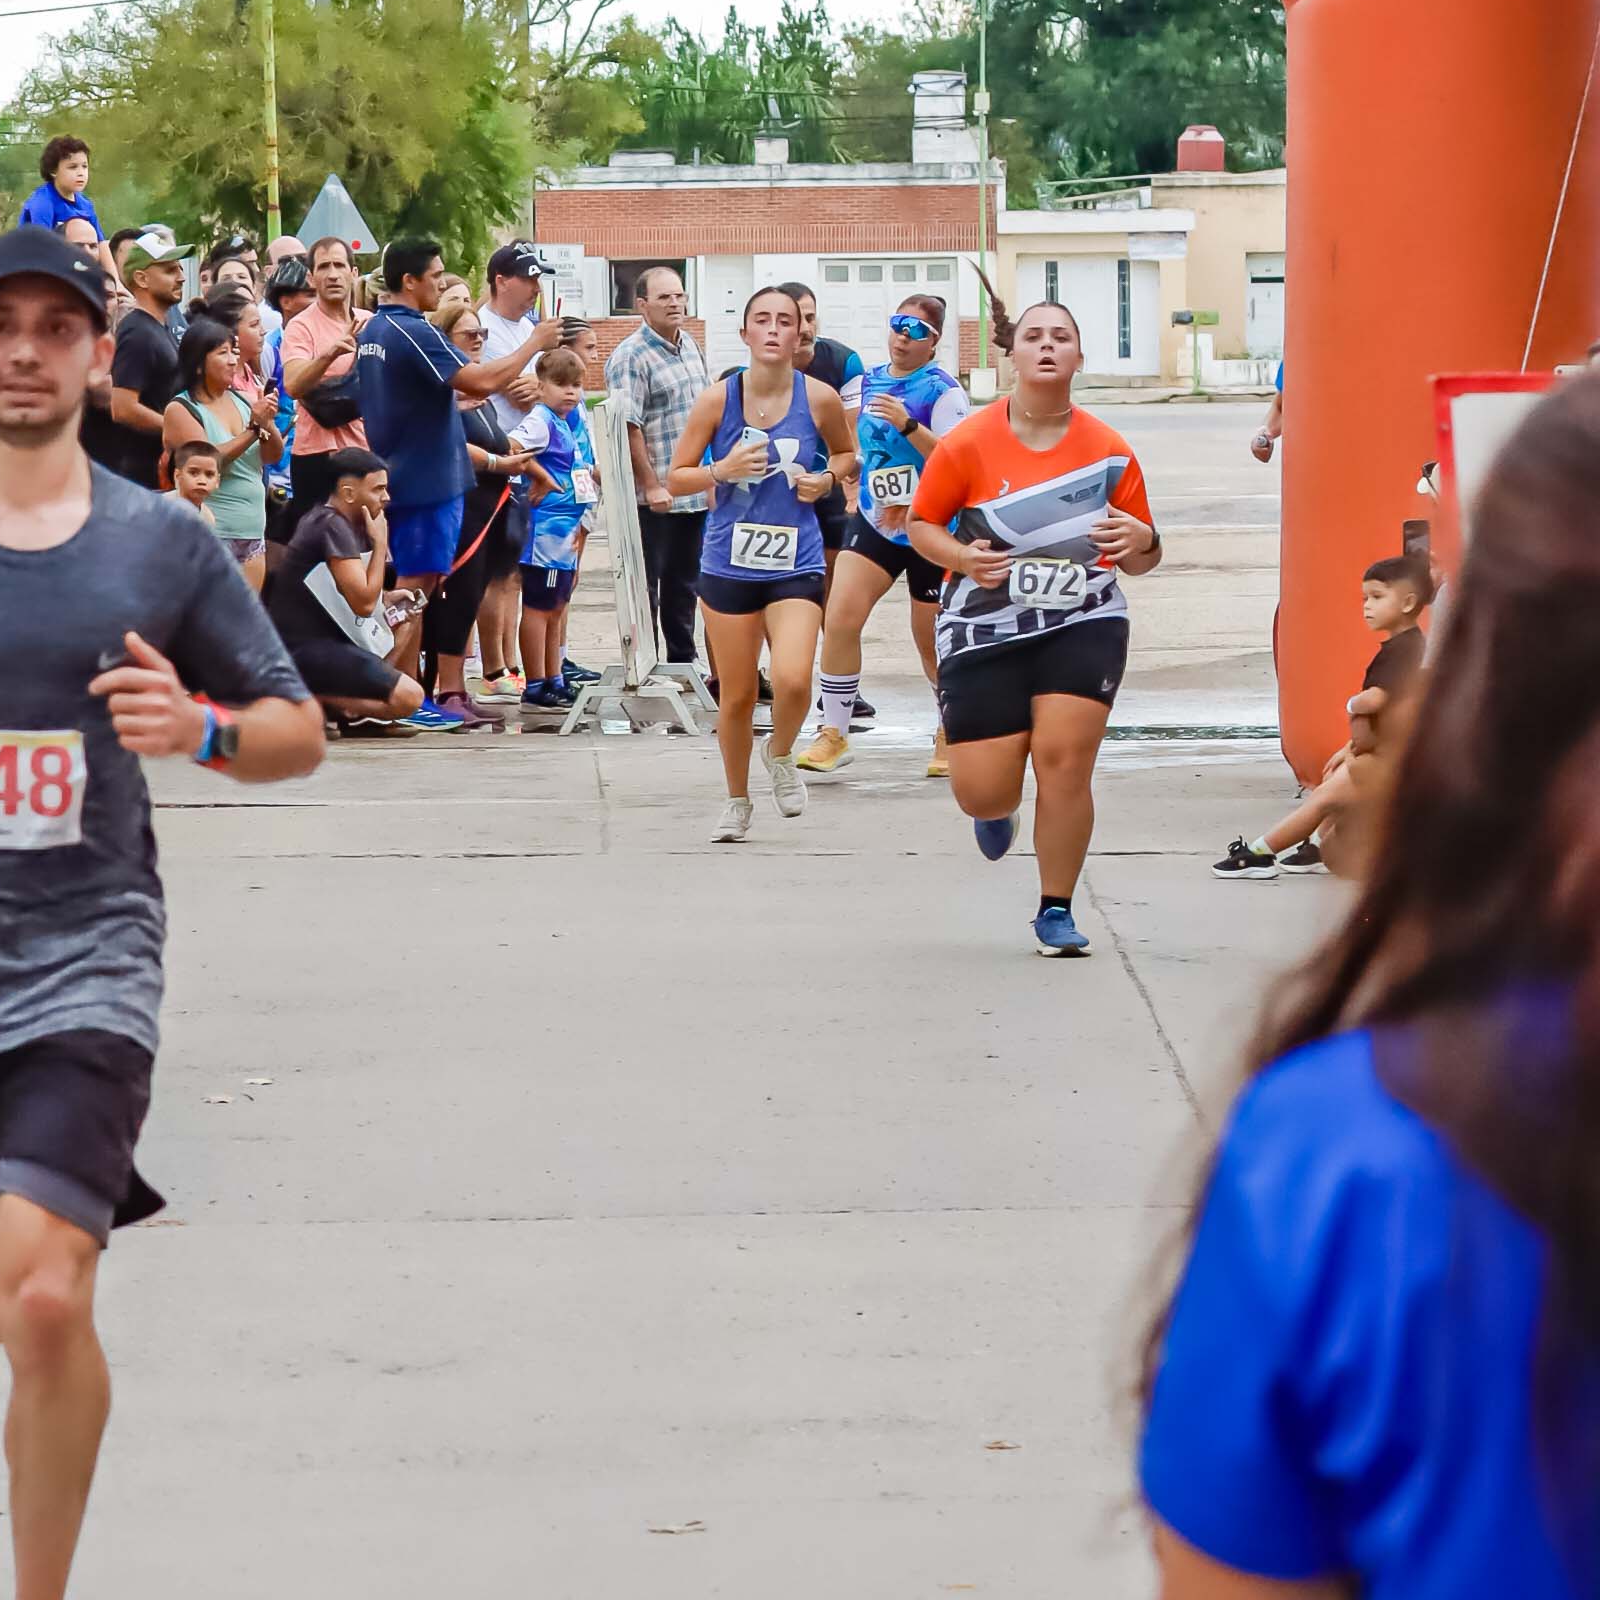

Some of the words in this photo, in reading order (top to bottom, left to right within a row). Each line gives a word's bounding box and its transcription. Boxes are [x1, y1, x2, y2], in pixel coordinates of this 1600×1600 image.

[872, 469, 912, 499] 687
[740, 528, 790, 560] 722
[1018, 562, 1080, 596] 672
